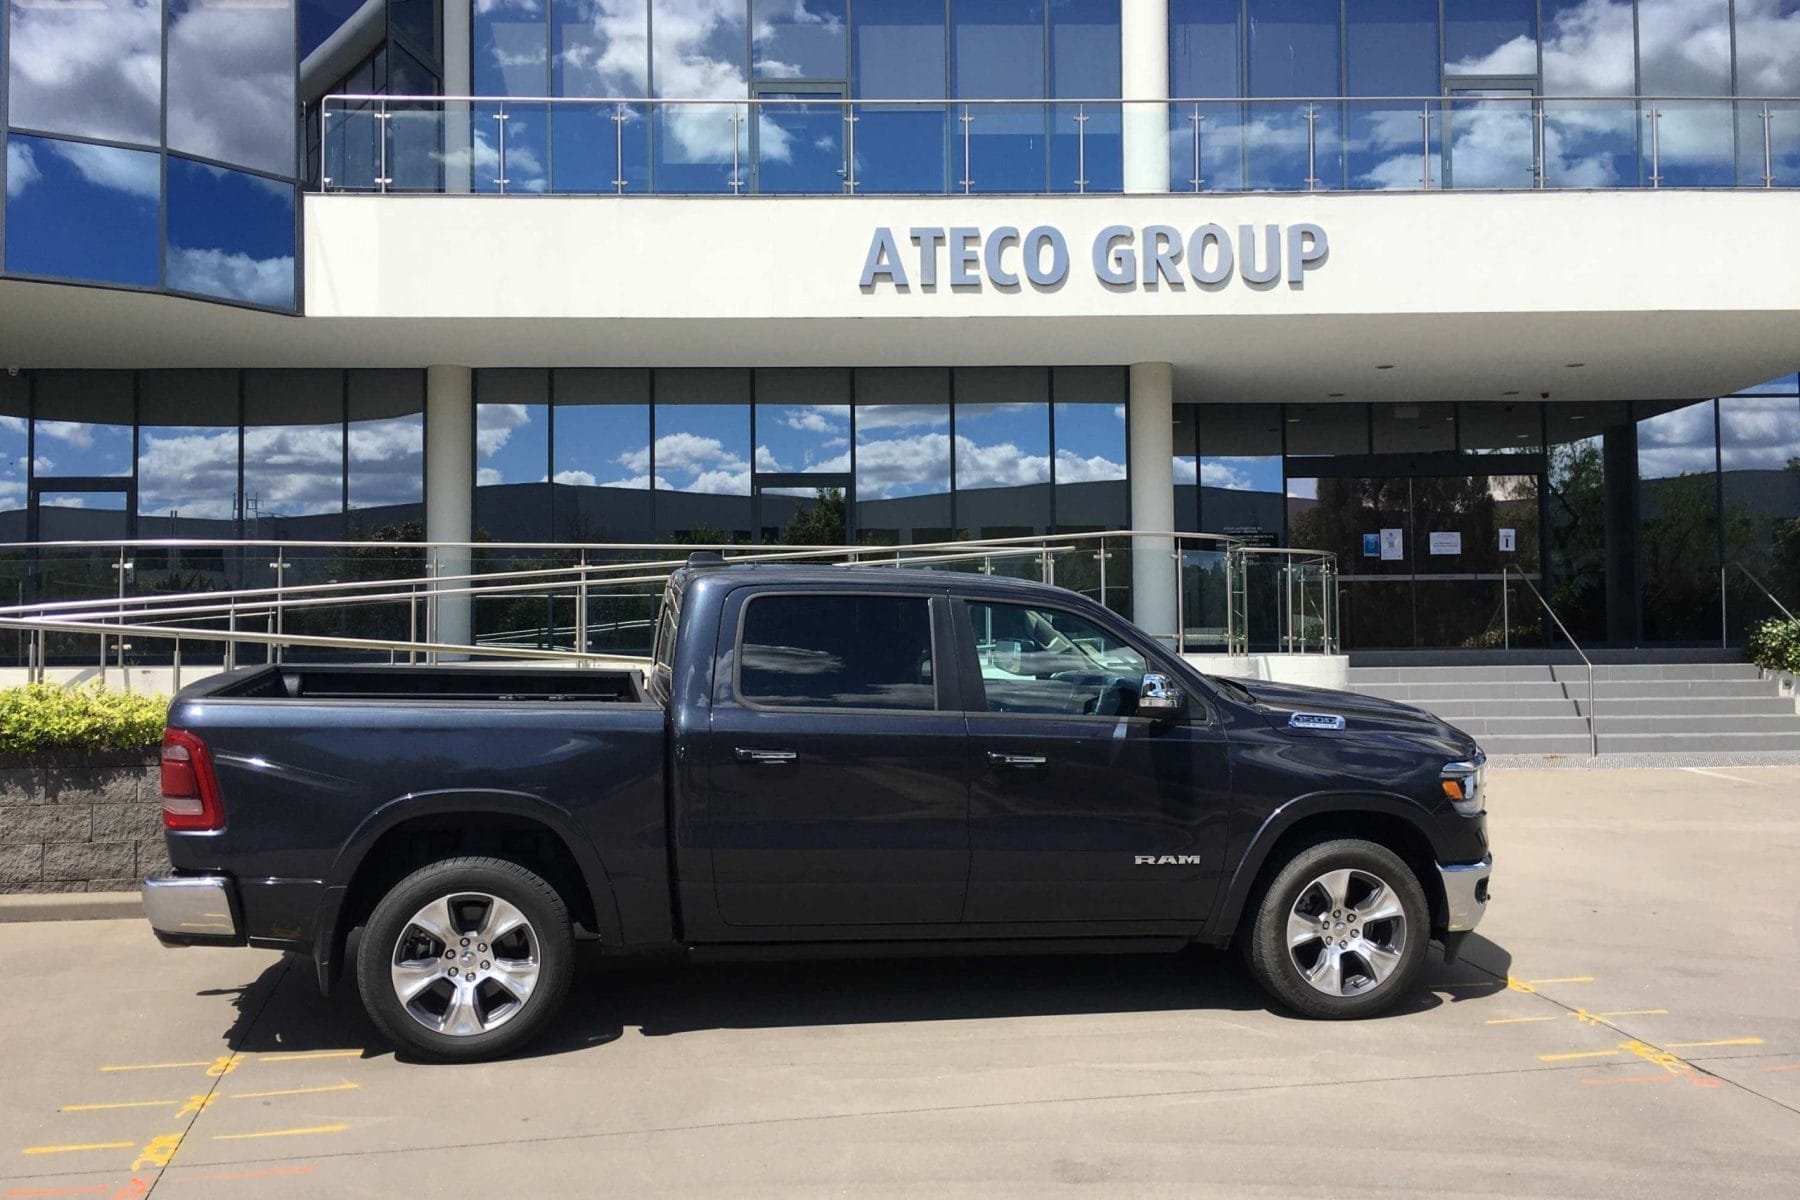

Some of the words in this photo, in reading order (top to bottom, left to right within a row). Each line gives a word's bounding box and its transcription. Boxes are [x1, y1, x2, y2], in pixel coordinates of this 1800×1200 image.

[859, 225, 1070, 291] ATECO
[1091, 223, 1329, 290] GROUP
[1134, 855, 1201, 865] RAM
